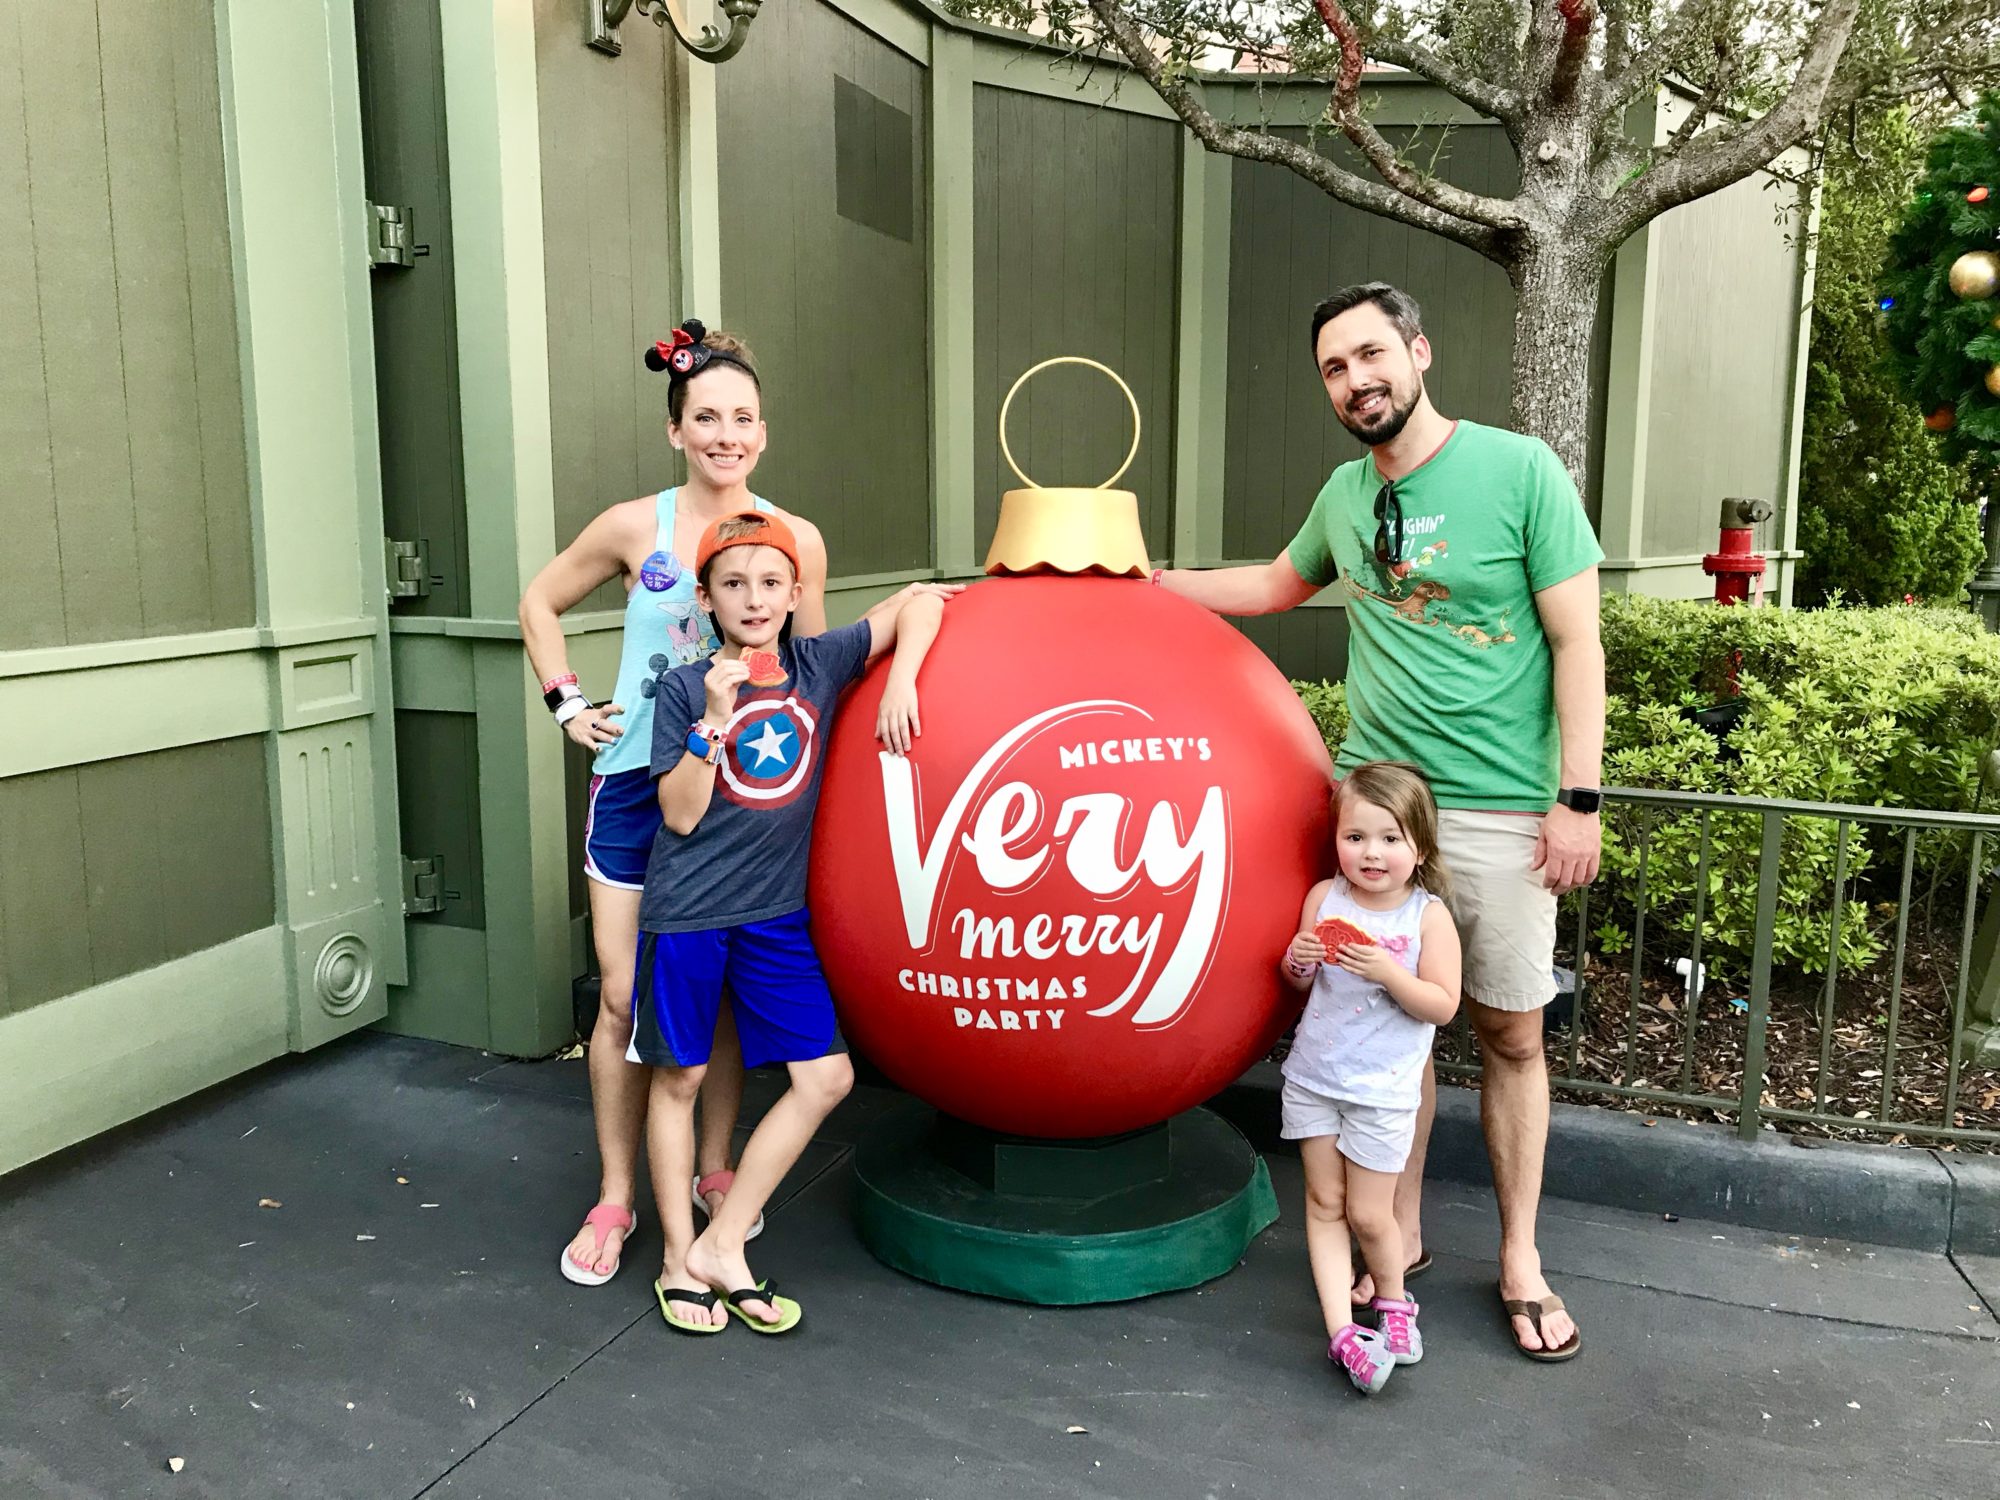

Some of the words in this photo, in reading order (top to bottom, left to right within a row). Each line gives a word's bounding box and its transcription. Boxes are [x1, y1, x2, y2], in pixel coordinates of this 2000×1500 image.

[1386, 514, 1445, 536] LIGHIN'
[1060, 737, 1212, 769] MICKEY'S
[879, 700, 1227, 1024] Very
[951, 908, 1164, 1017] merry
[898, 969, 1087, 1000] CHRISTMAS
[954, 1007, 1065, 1030] PARTY
